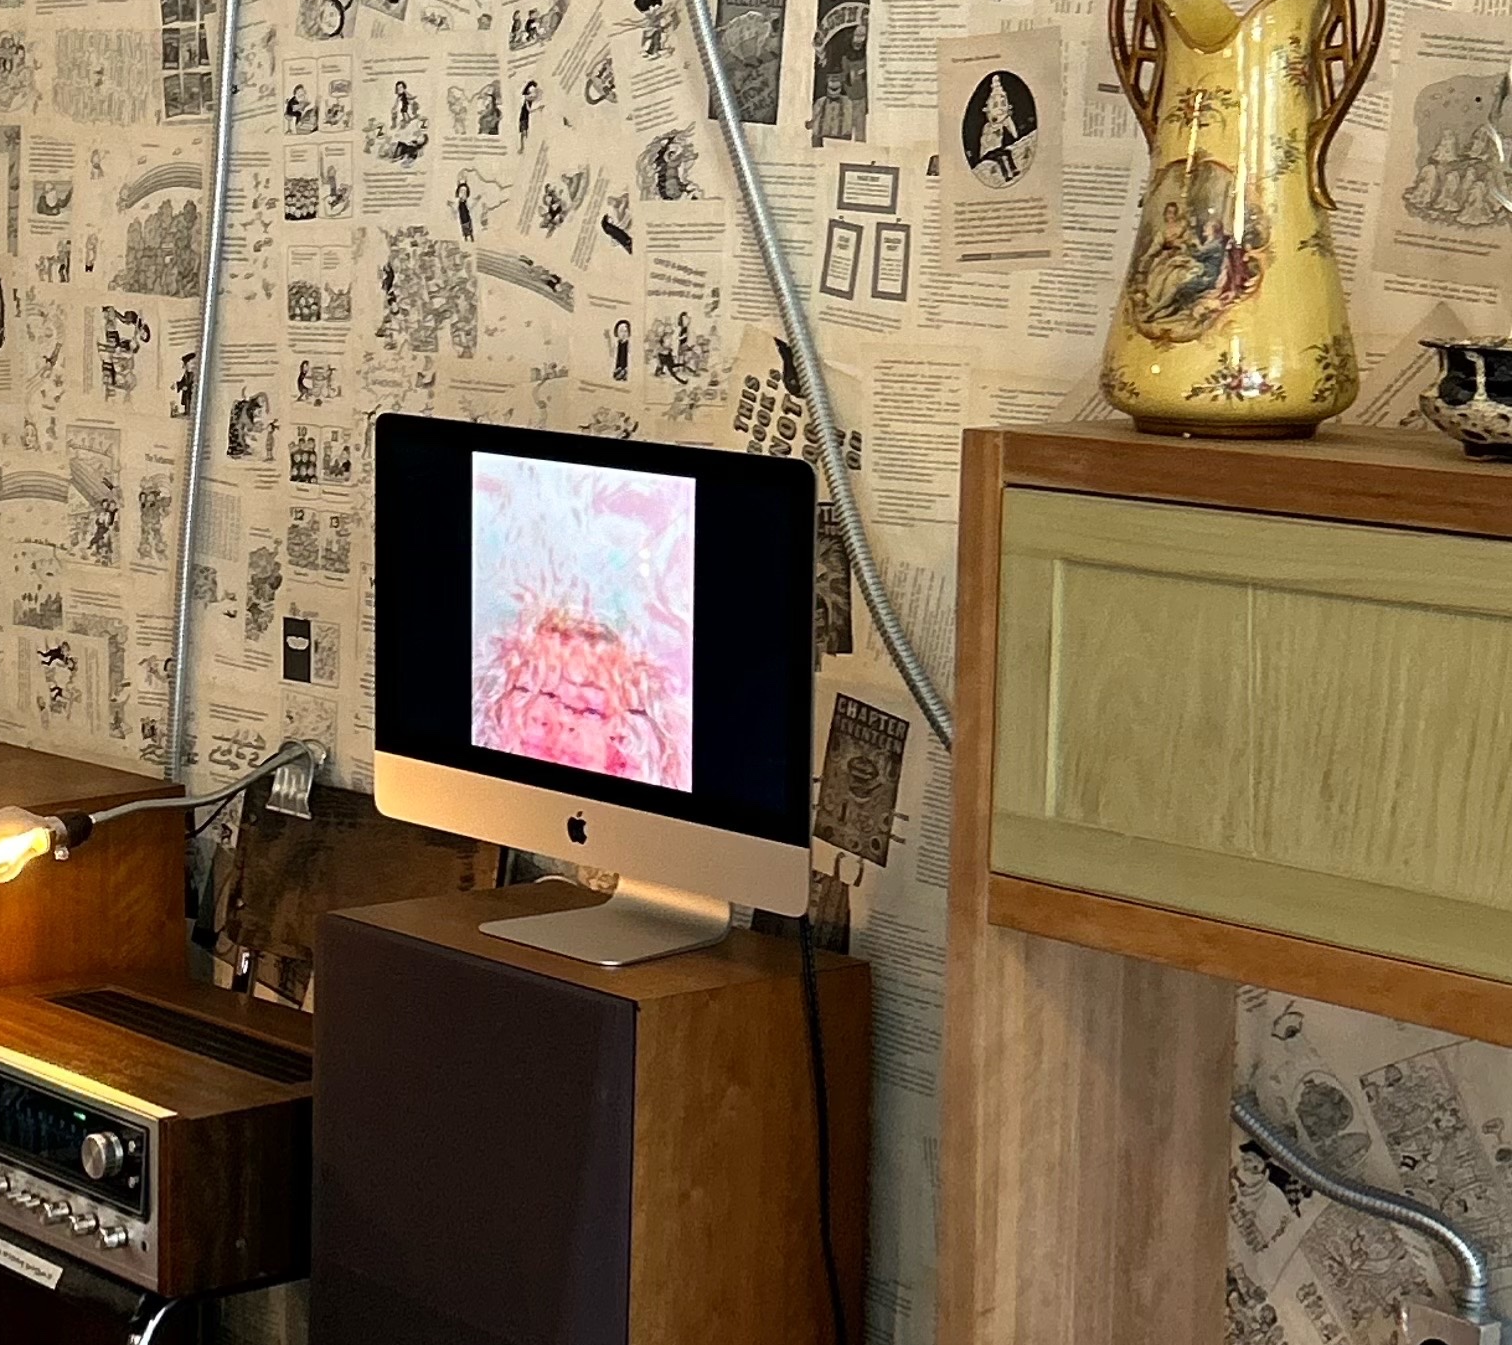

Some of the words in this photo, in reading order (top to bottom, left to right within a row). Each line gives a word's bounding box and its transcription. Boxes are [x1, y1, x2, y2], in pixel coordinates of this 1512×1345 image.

[733, 374, 761, 433] THIS
[747, 391, 777, 455] BOOK
[766, 367, 782, 392] IS
[768, 392, 803, 457] NOT
[837, 697, 908, 740] CHAPTER
